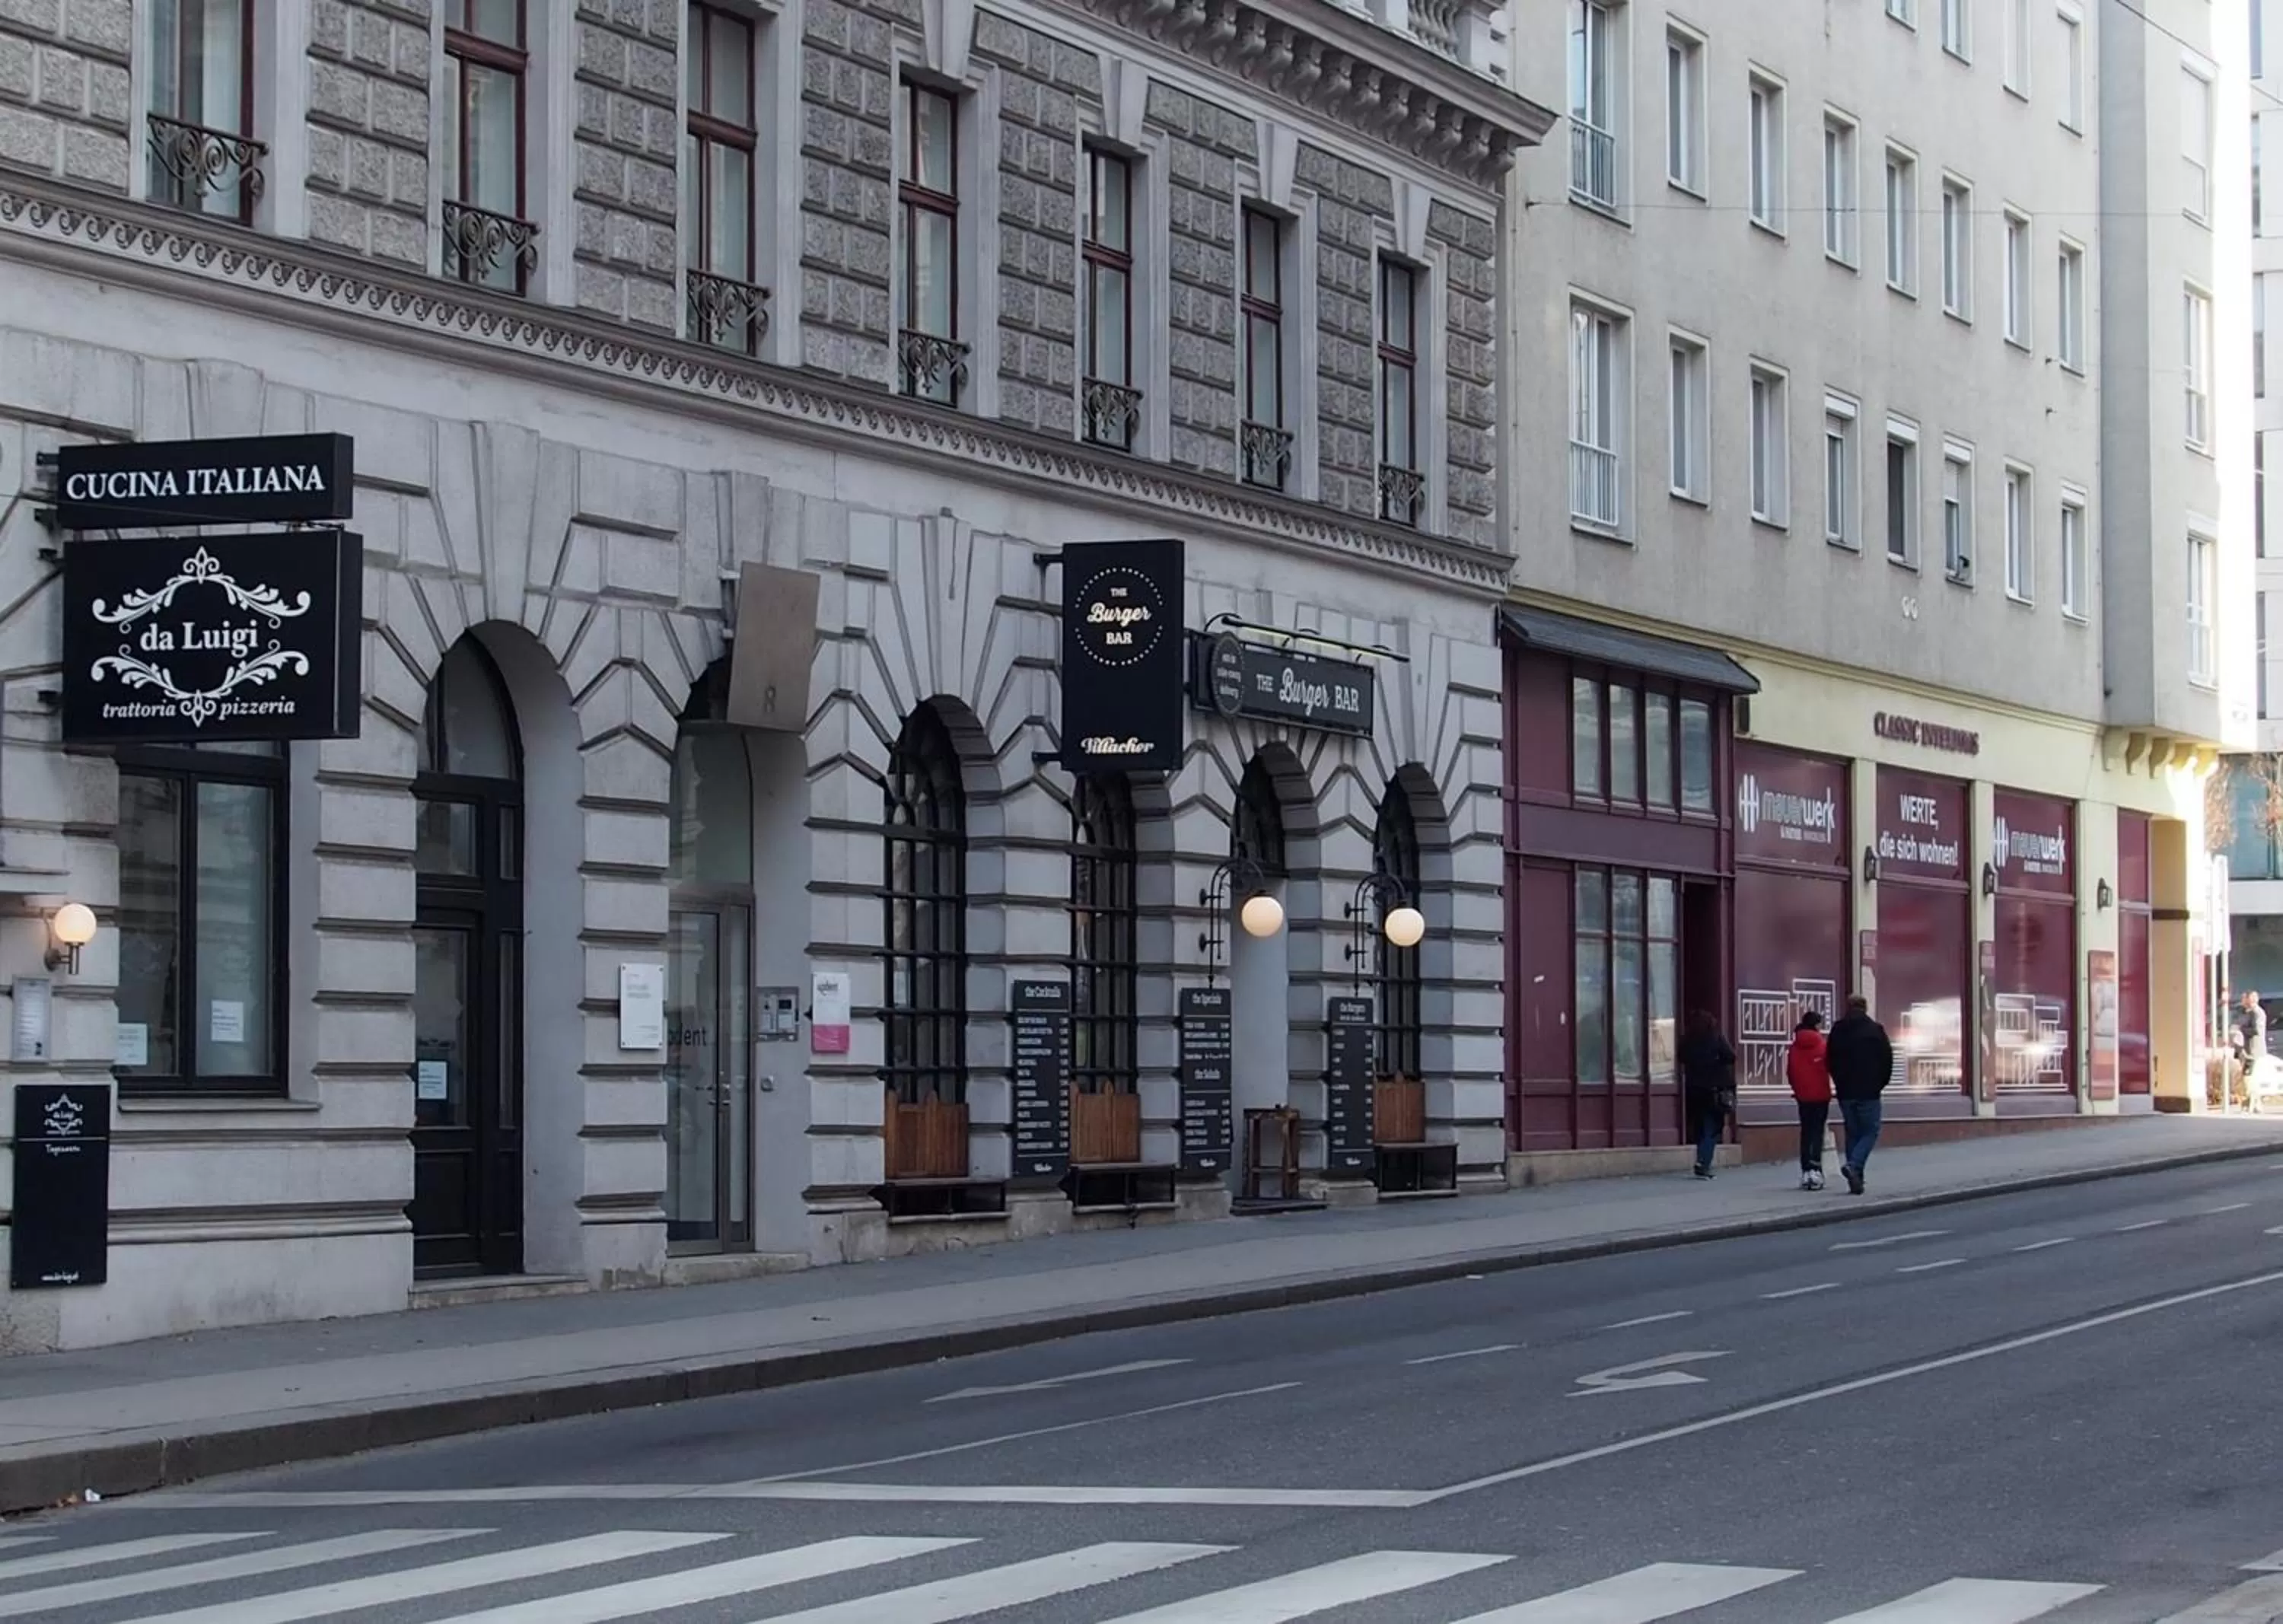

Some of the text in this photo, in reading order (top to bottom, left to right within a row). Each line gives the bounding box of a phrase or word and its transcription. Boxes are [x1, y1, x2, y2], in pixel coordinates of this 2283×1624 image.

[66, 464, 326, 500] CUCINA ITALIANA
[1110, 587, 1129, 597] THE
[1086, 602, 1153, 628] Burger
[139, 619, 259, 658] da Luigi
[1106, 631, 1133, 645] BAR
[1256, 673, 1274, 693] THE
[1278, 667, 1330, 717] Burger
[1333, 684, 1360, 713] BAR
[102, 696, 295, 721] trattoria pizzeria
[1899, 793, 1940, 831] WERTE,
